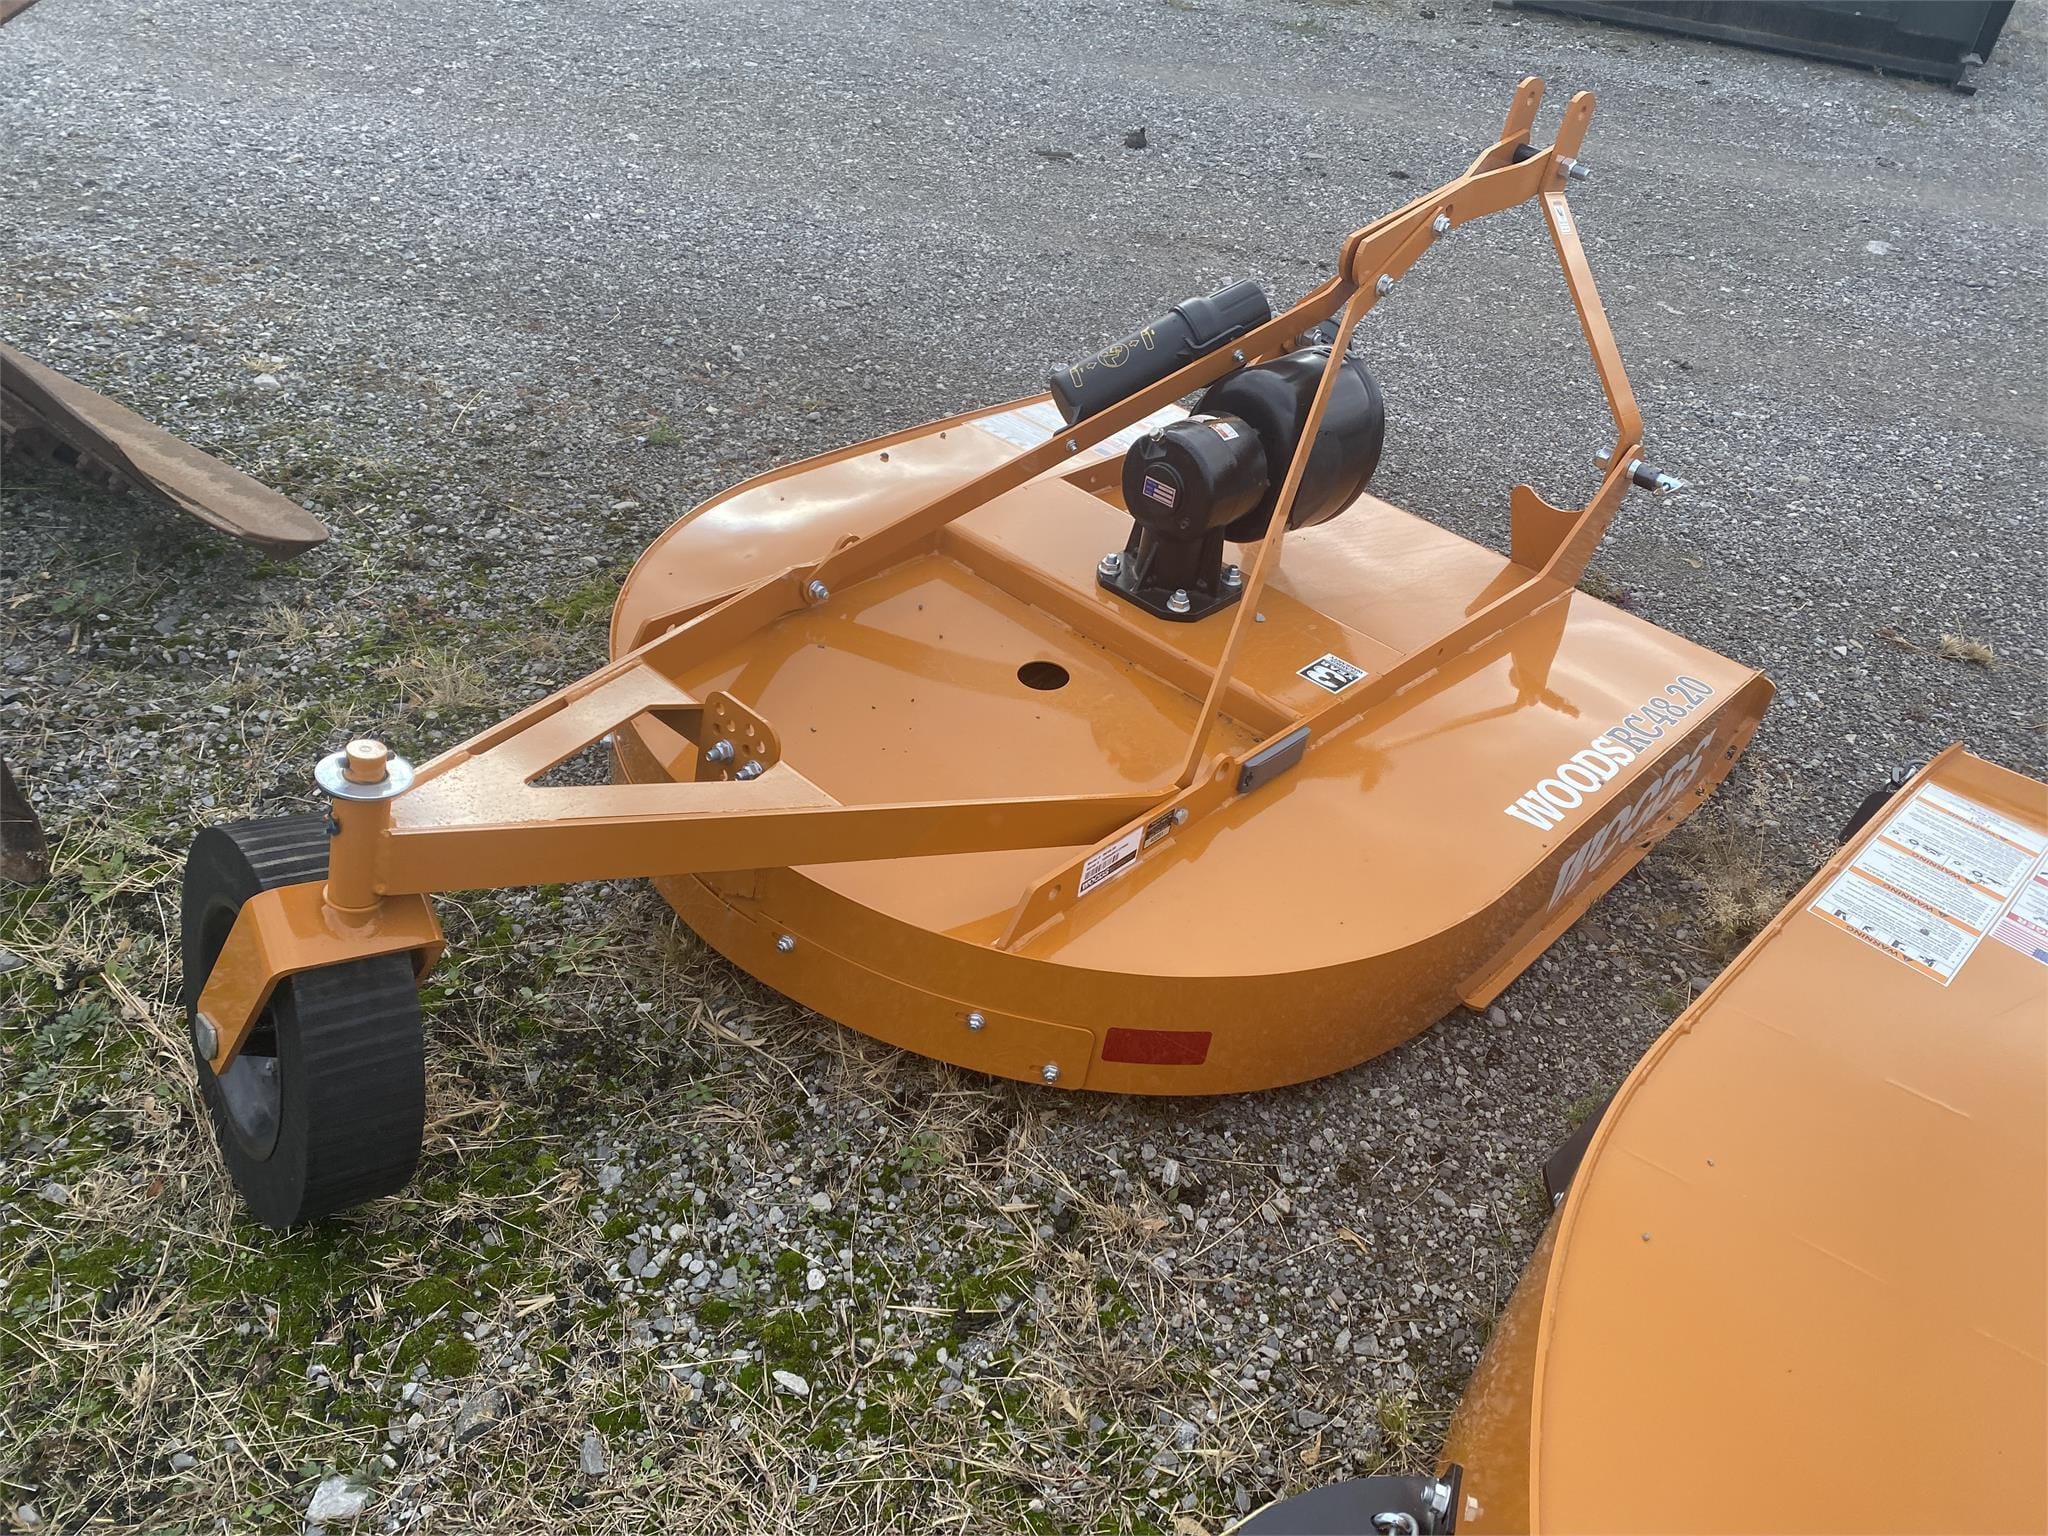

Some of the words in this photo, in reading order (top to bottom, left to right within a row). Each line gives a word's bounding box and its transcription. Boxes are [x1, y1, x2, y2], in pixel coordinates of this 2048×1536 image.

[1911, 853, 1961, 880] WARNING
[1882, 883, 1934, 913] WARNING
[1846, 925, 1899, 957] WARNING
